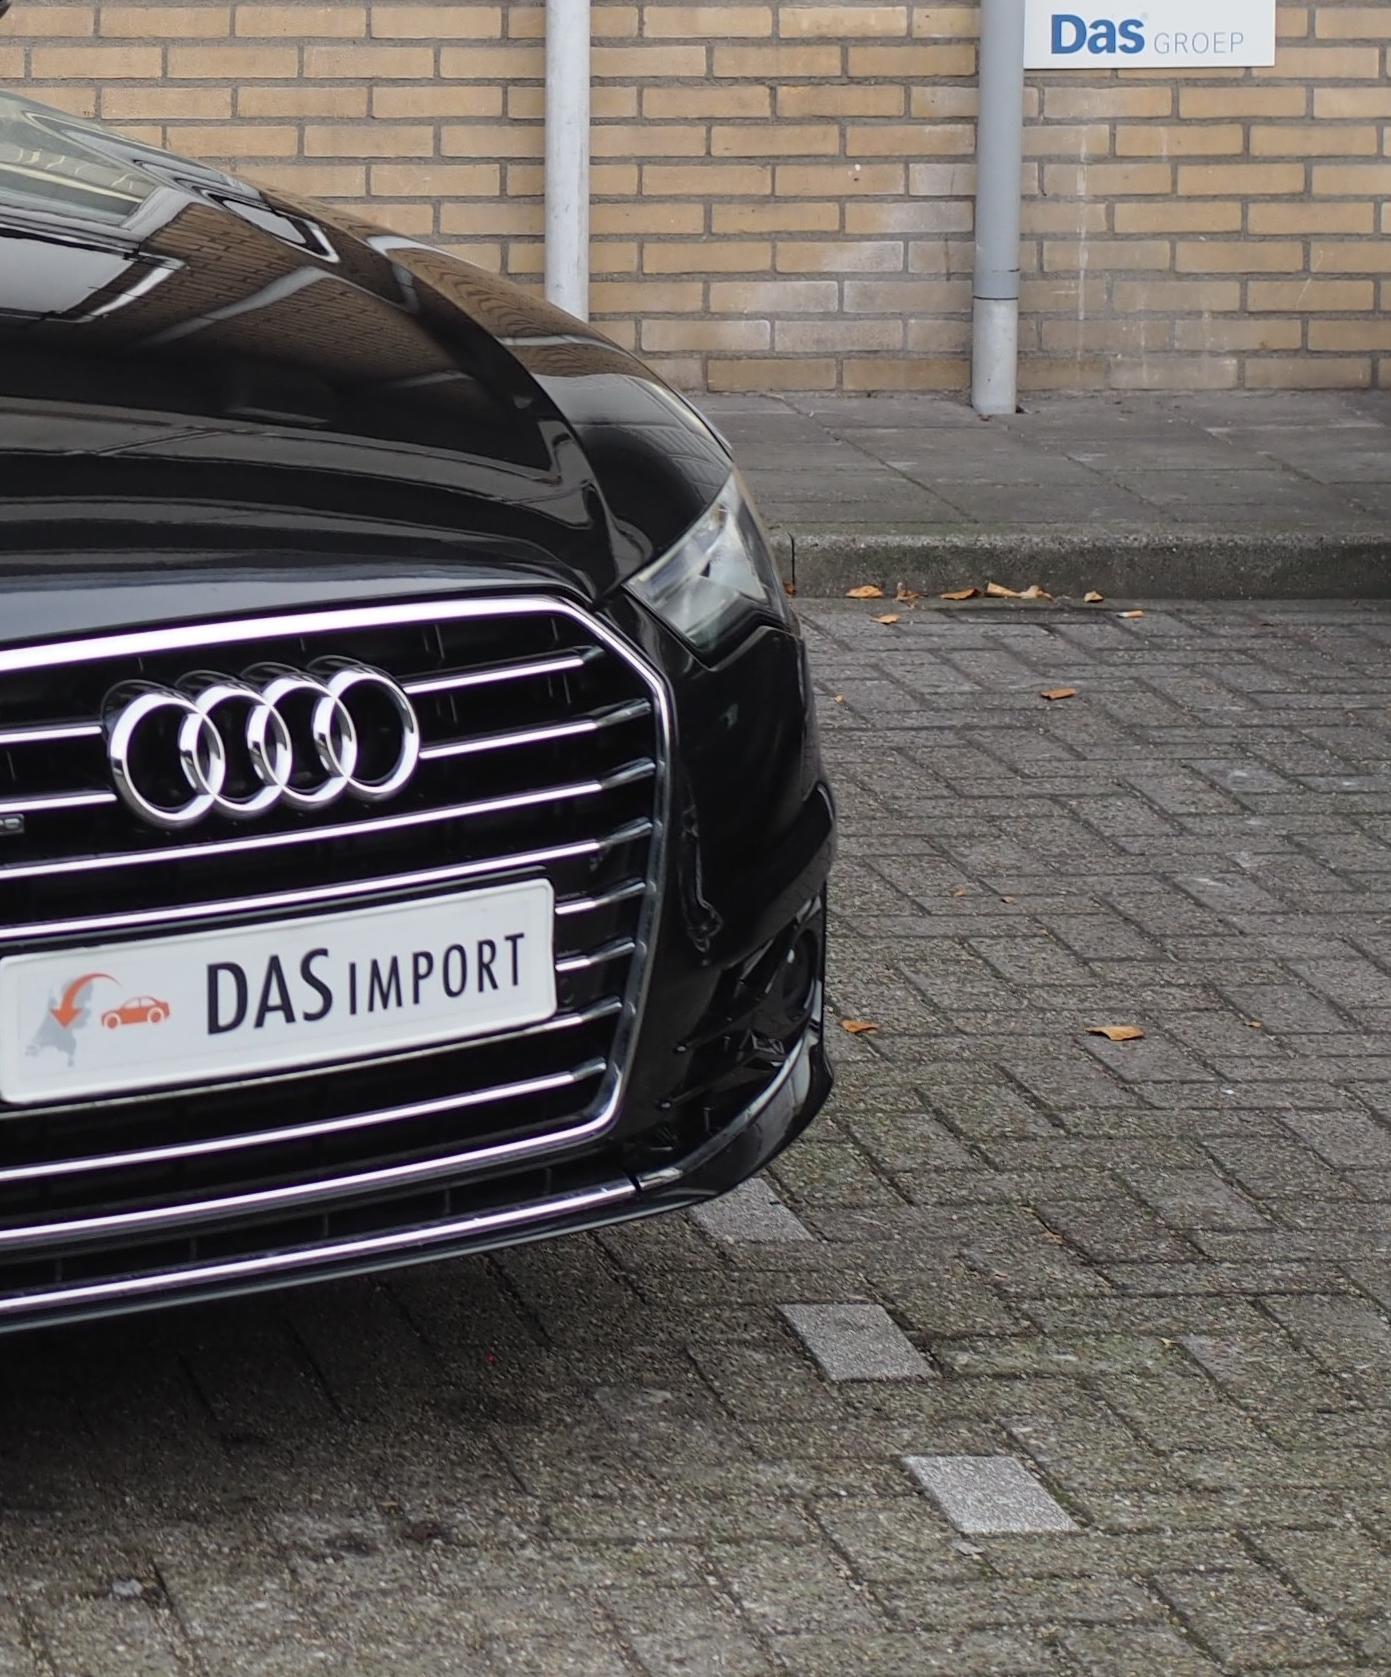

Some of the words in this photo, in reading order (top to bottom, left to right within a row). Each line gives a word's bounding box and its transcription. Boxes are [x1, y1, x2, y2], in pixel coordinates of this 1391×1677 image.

[1051, 13, 1145, 55] Das
[1154, 31, 1244, 54] GROEP
[206, 947, 334, 1035] DAS
[348, 932, 526, 1016] IMPORT
